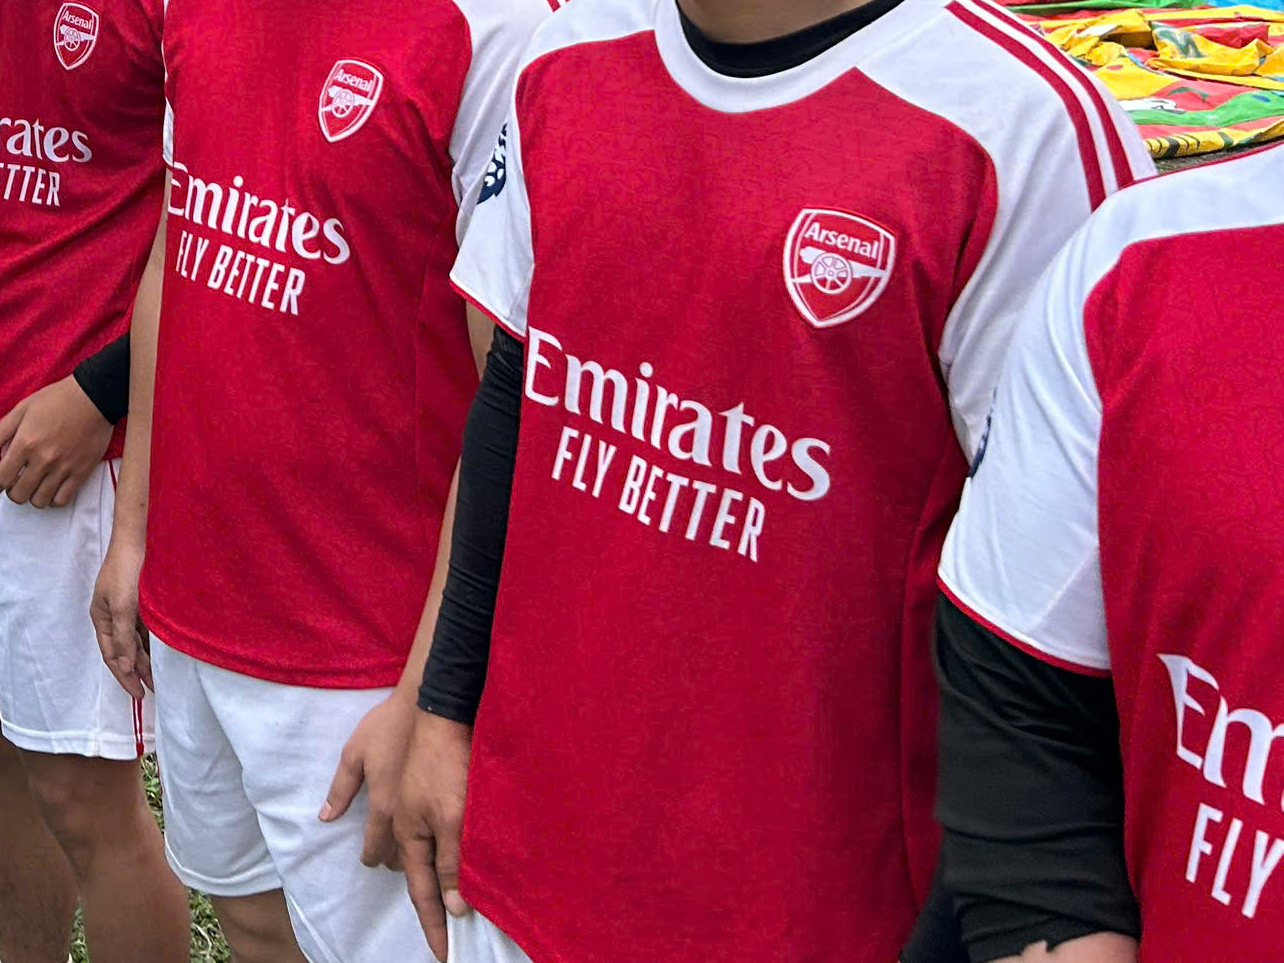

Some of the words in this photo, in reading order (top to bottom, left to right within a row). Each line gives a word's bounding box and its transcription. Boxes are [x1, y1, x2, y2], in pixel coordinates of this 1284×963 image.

[61, 10, 93, 30] Arsenal
[333, 68, 373, 93] Arsenal
[167, 161, 351, 265] Emirates
[804, 221, 880, 260] Arsenal
[175, 229, 210, 282] FLY
[207, 244, 306, 316] BETTER
[525, 326, 831, 501] Emirates
[551, 425, 617, 498] FLY
[618, 454, 766, 563] BETTER
[1156, 653, 1284, 812] Em
[1185, 802, 1284, 919] FLY
